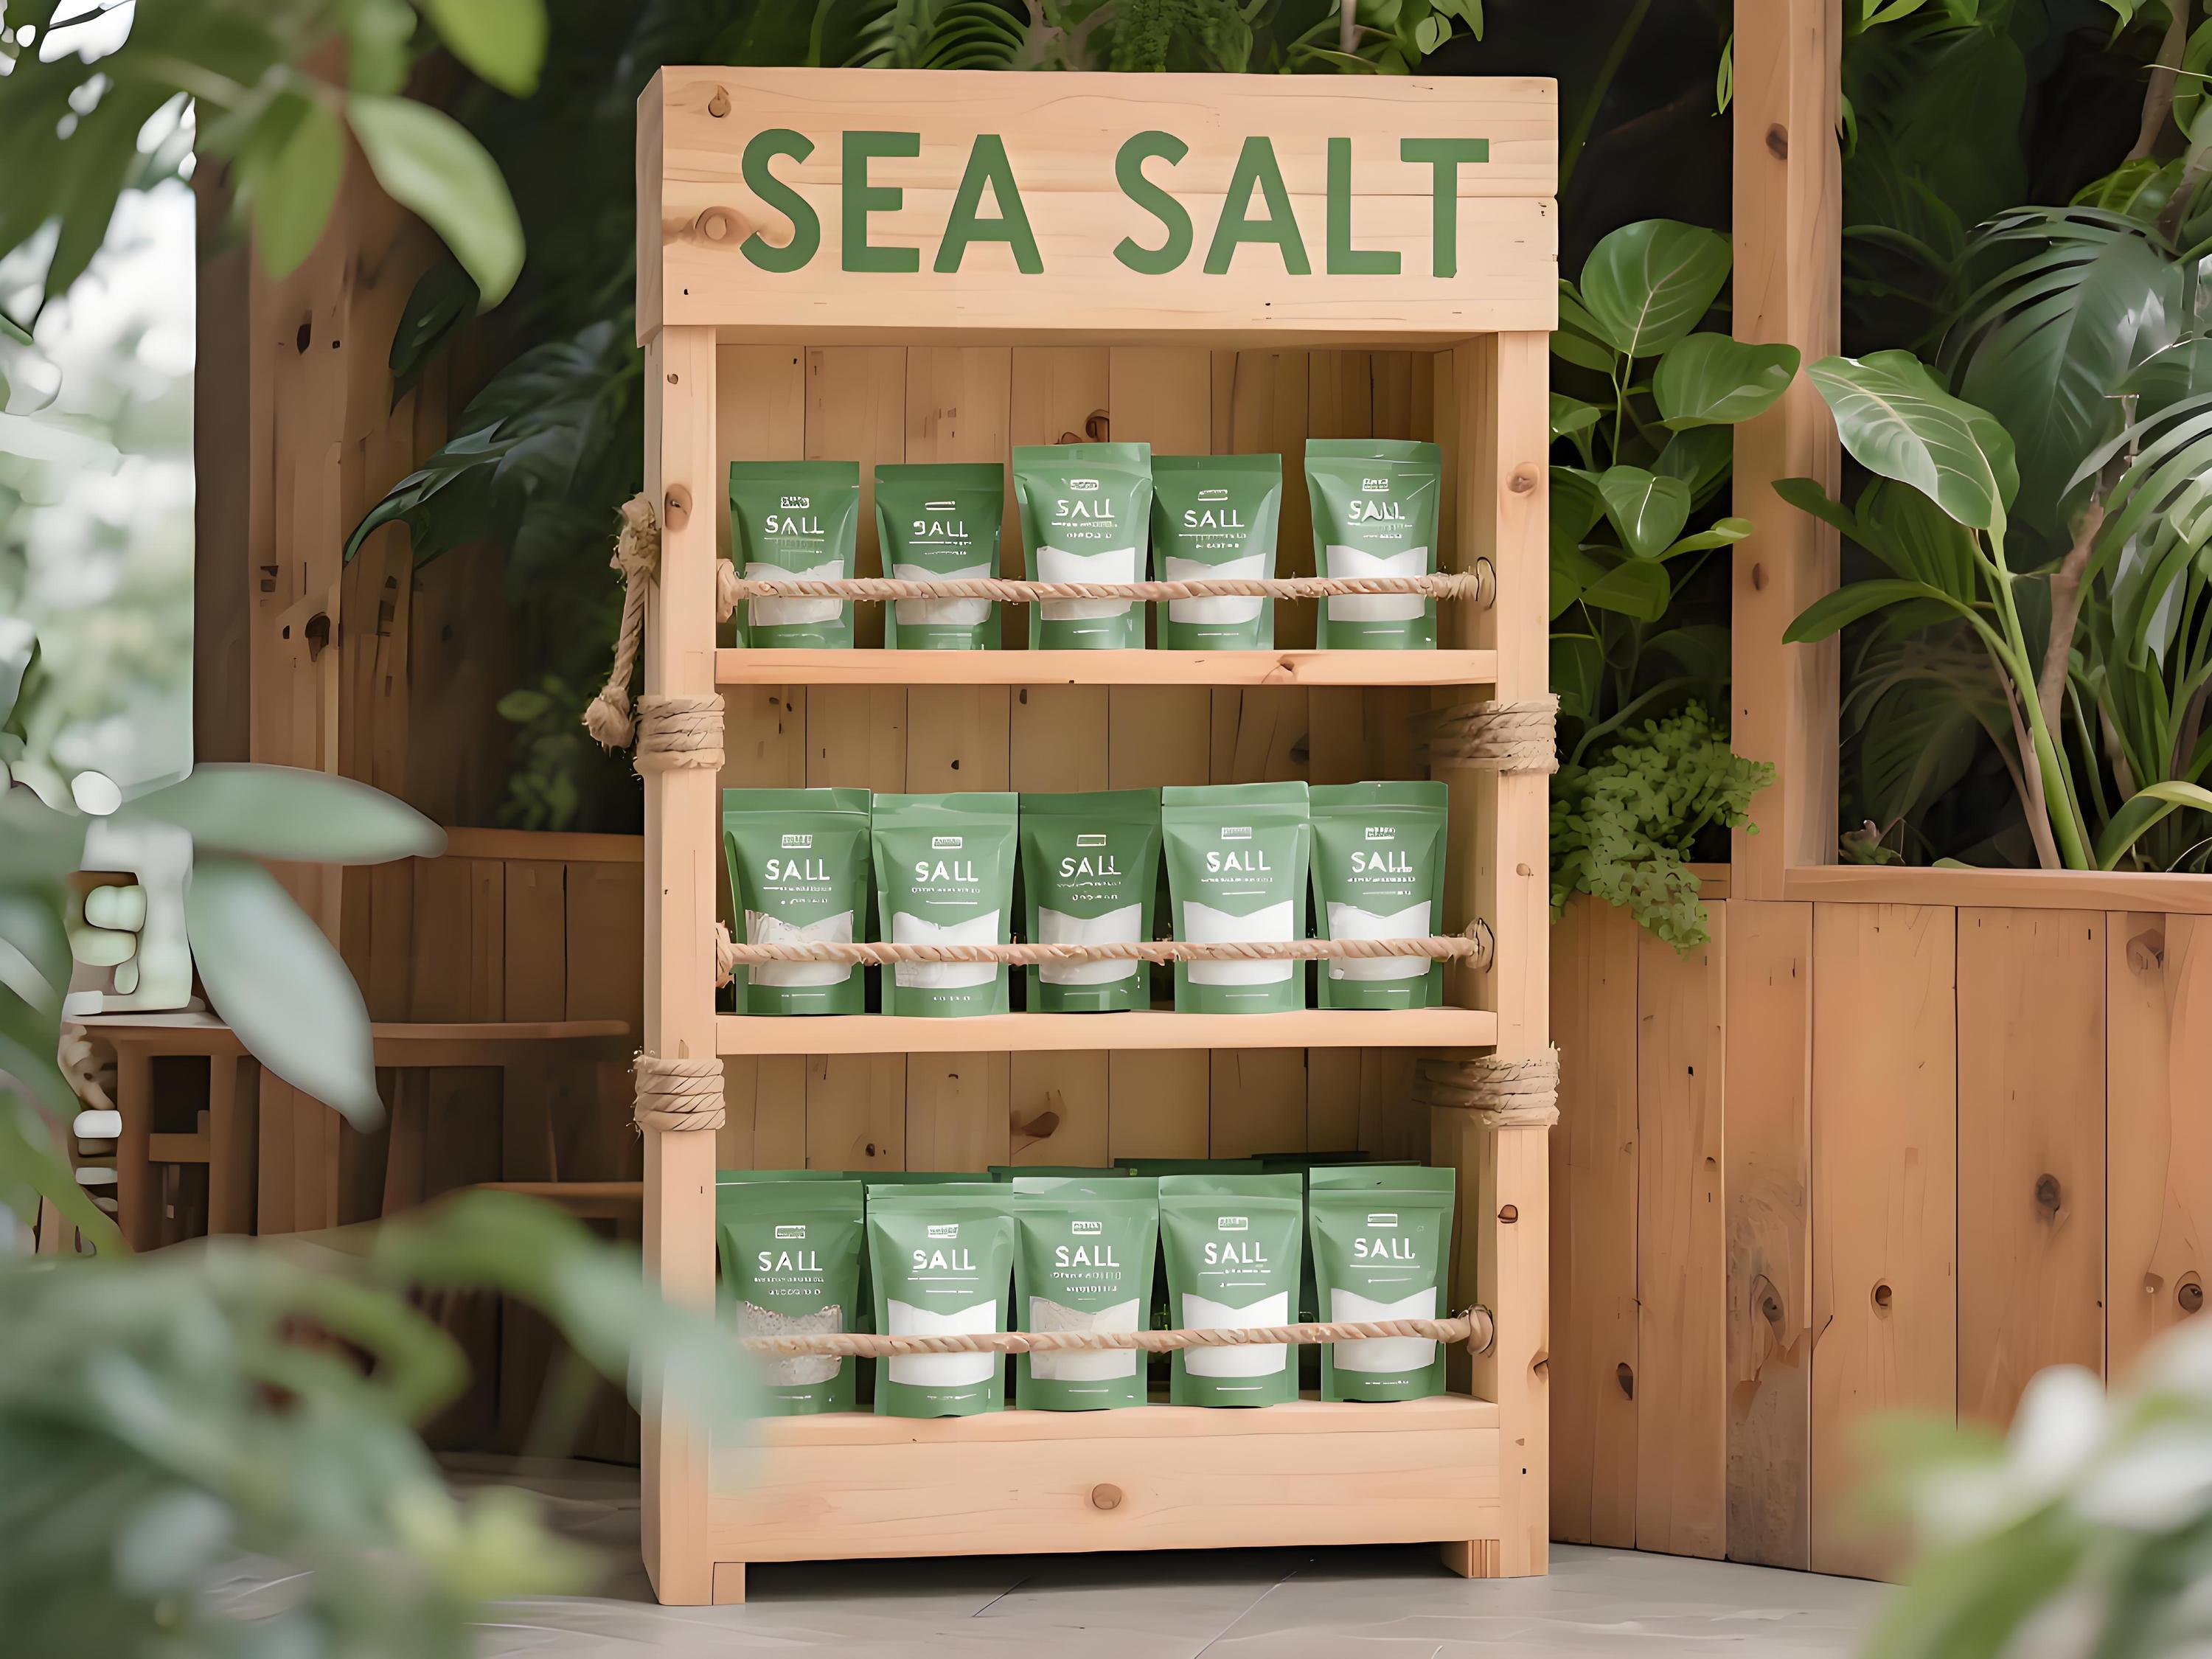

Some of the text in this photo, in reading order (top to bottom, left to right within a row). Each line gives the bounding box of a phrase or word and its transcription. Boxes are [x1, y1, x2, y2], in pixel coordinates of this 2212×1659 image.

[739, 128, 1489, 278] SEA SALT
[765, 859, 830, 882] SALL
[914, 860, 979, 882] SALL
[1206, 850, 1271, 873] SALL
[1351, 851, 1413, 873] SALL
[758, 1251, 823, 1272] SALL
[1055, 1245, 1119, 1267] SALL
[1204, 1242, 1267, 1265] SALL
